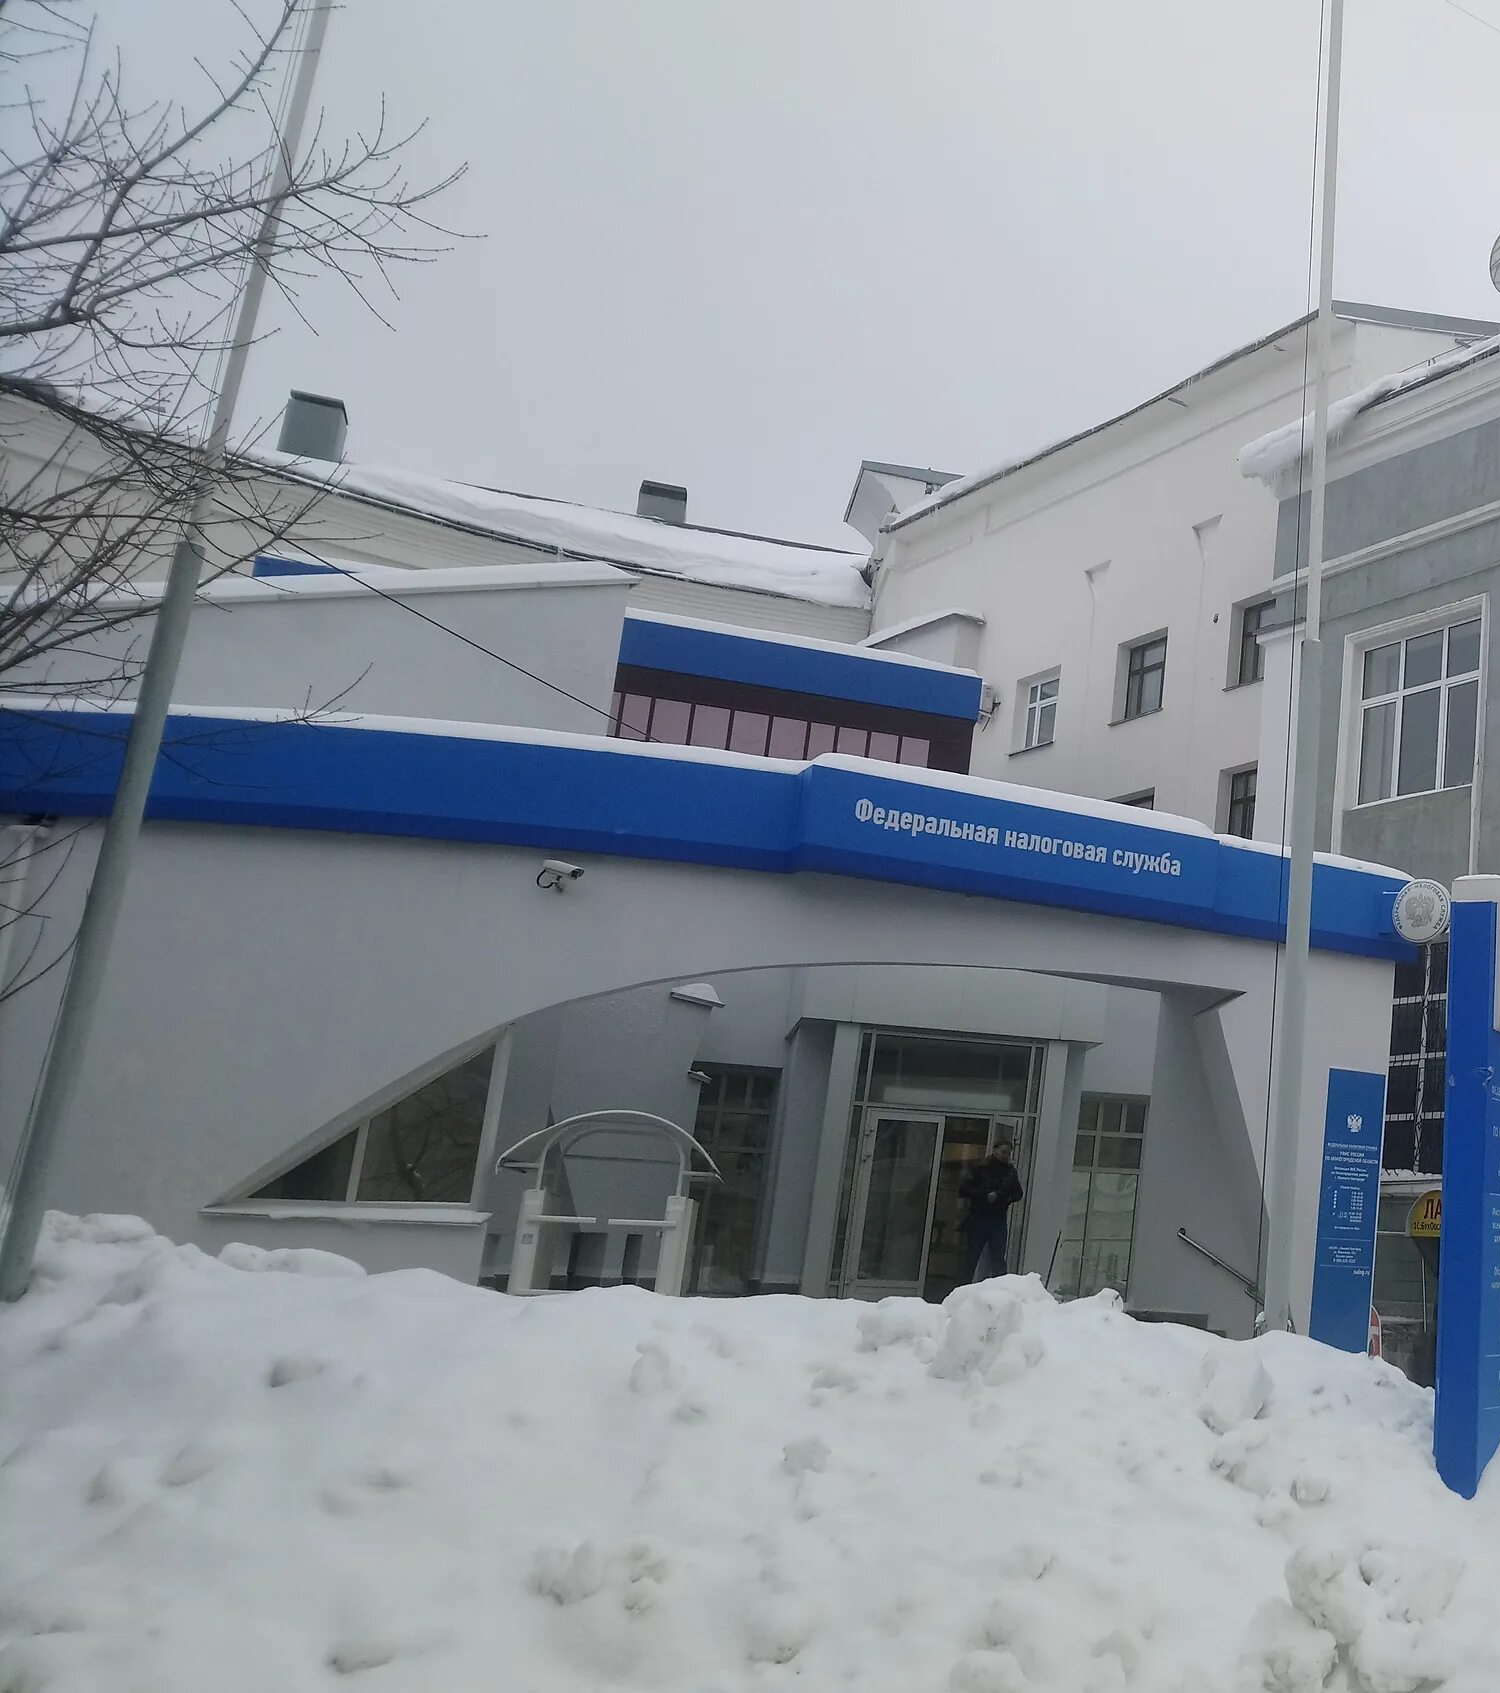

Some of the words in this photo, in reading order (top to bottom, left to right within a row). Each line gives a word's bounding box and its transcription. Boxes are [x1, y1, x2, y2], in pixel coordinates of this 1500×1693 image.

[854, 798, 998, 845] Федеральная
[1004, 829, 1107, 864] налоговая
[1112, 849, 1181, 877] служба
